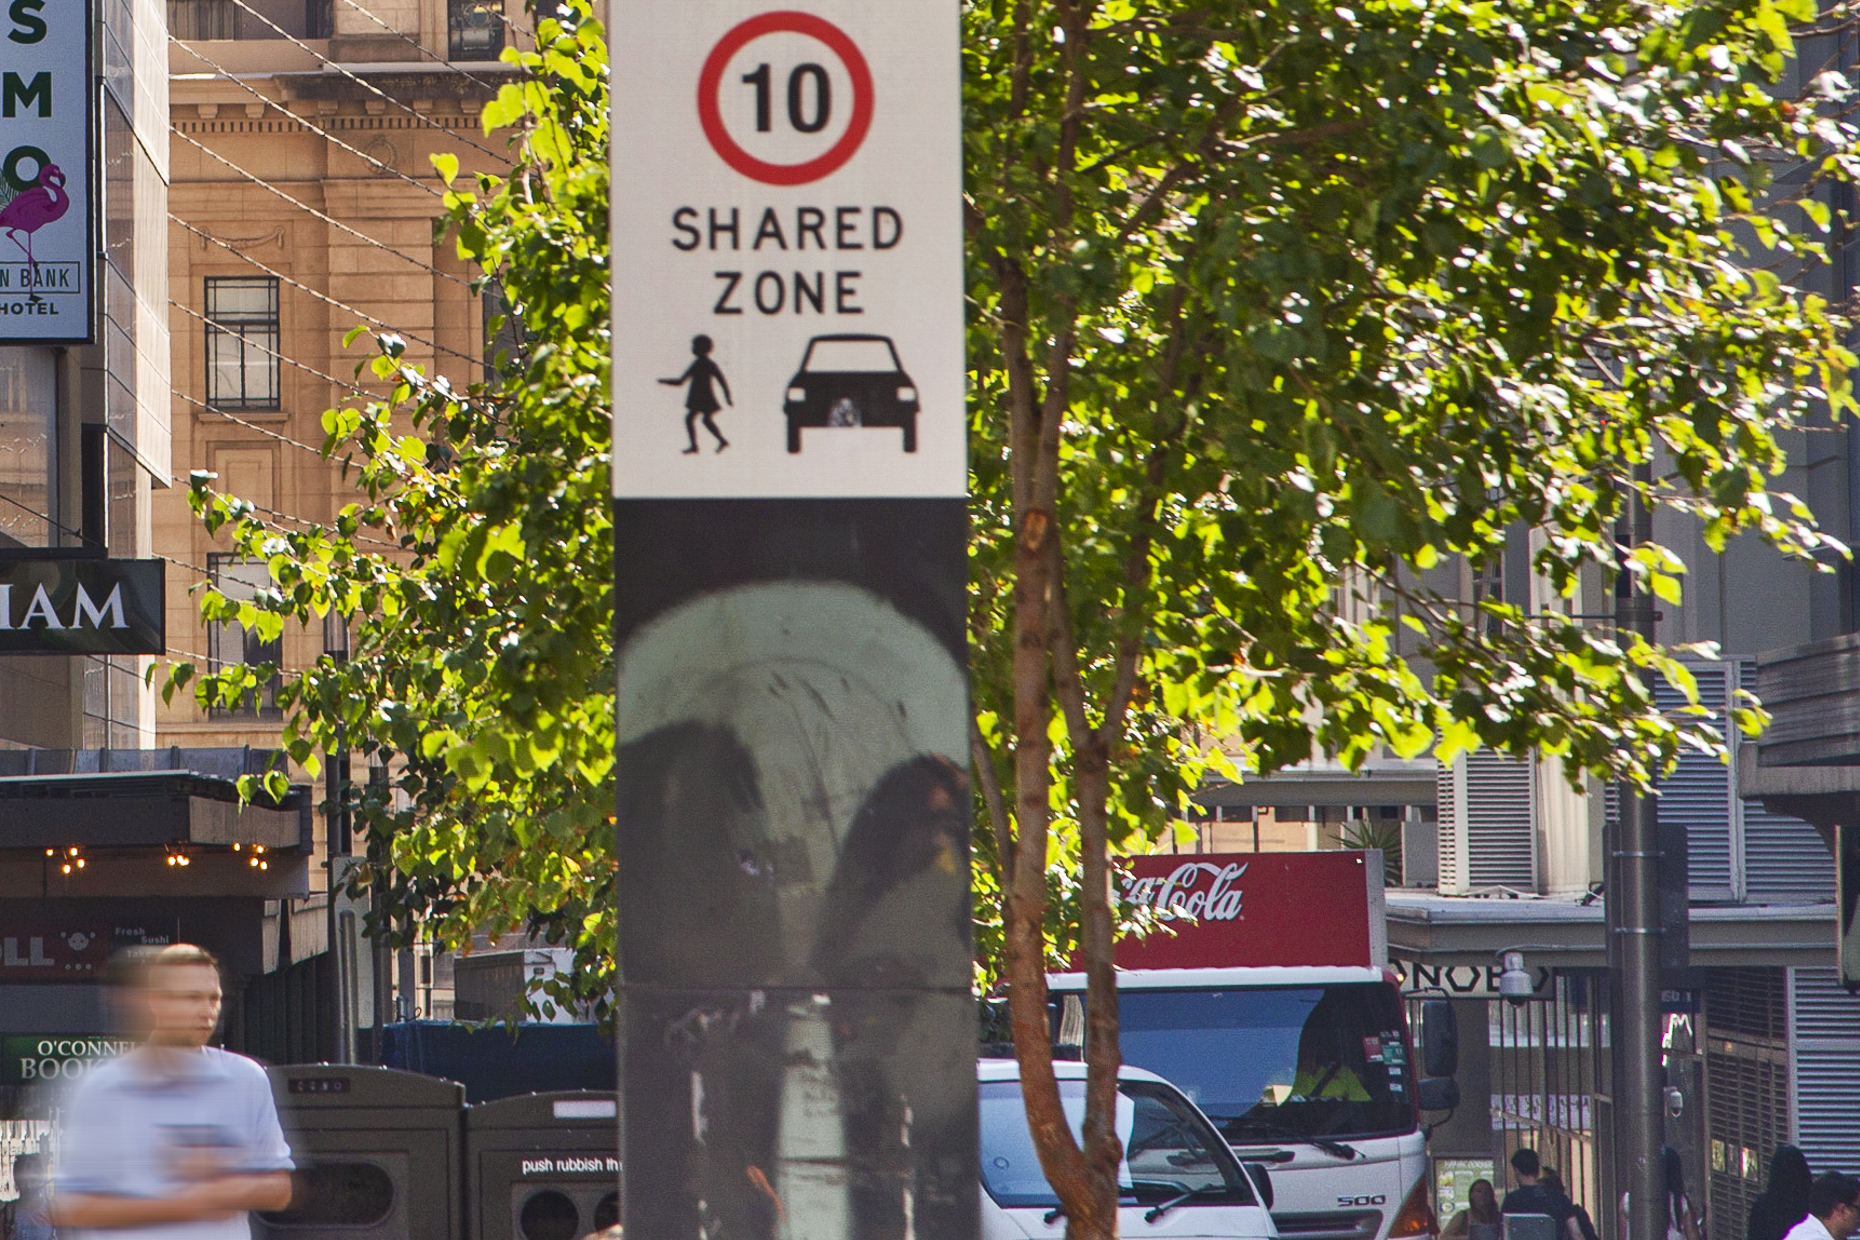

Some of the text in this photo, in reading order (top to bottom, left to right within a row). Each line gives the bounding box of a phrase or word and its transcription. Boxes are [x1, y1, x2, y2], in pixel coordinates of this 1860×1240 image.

[742, 62, 832, 133] 10
[671, 206, 905, 251] SHARED
[28, 267, 70, 289] BANK
[713, 270, 864, 315] ZONE
[115, 927, 146, 936] Fresh
[140, 935, 169, 944] Sushi
[20, 1057, 105, 1080] BOOK
[522, 1157, 553, 1175] push
[556, 1156, 604, 1172] rubbish
[1337, 1194, 1386, 1207] 500
